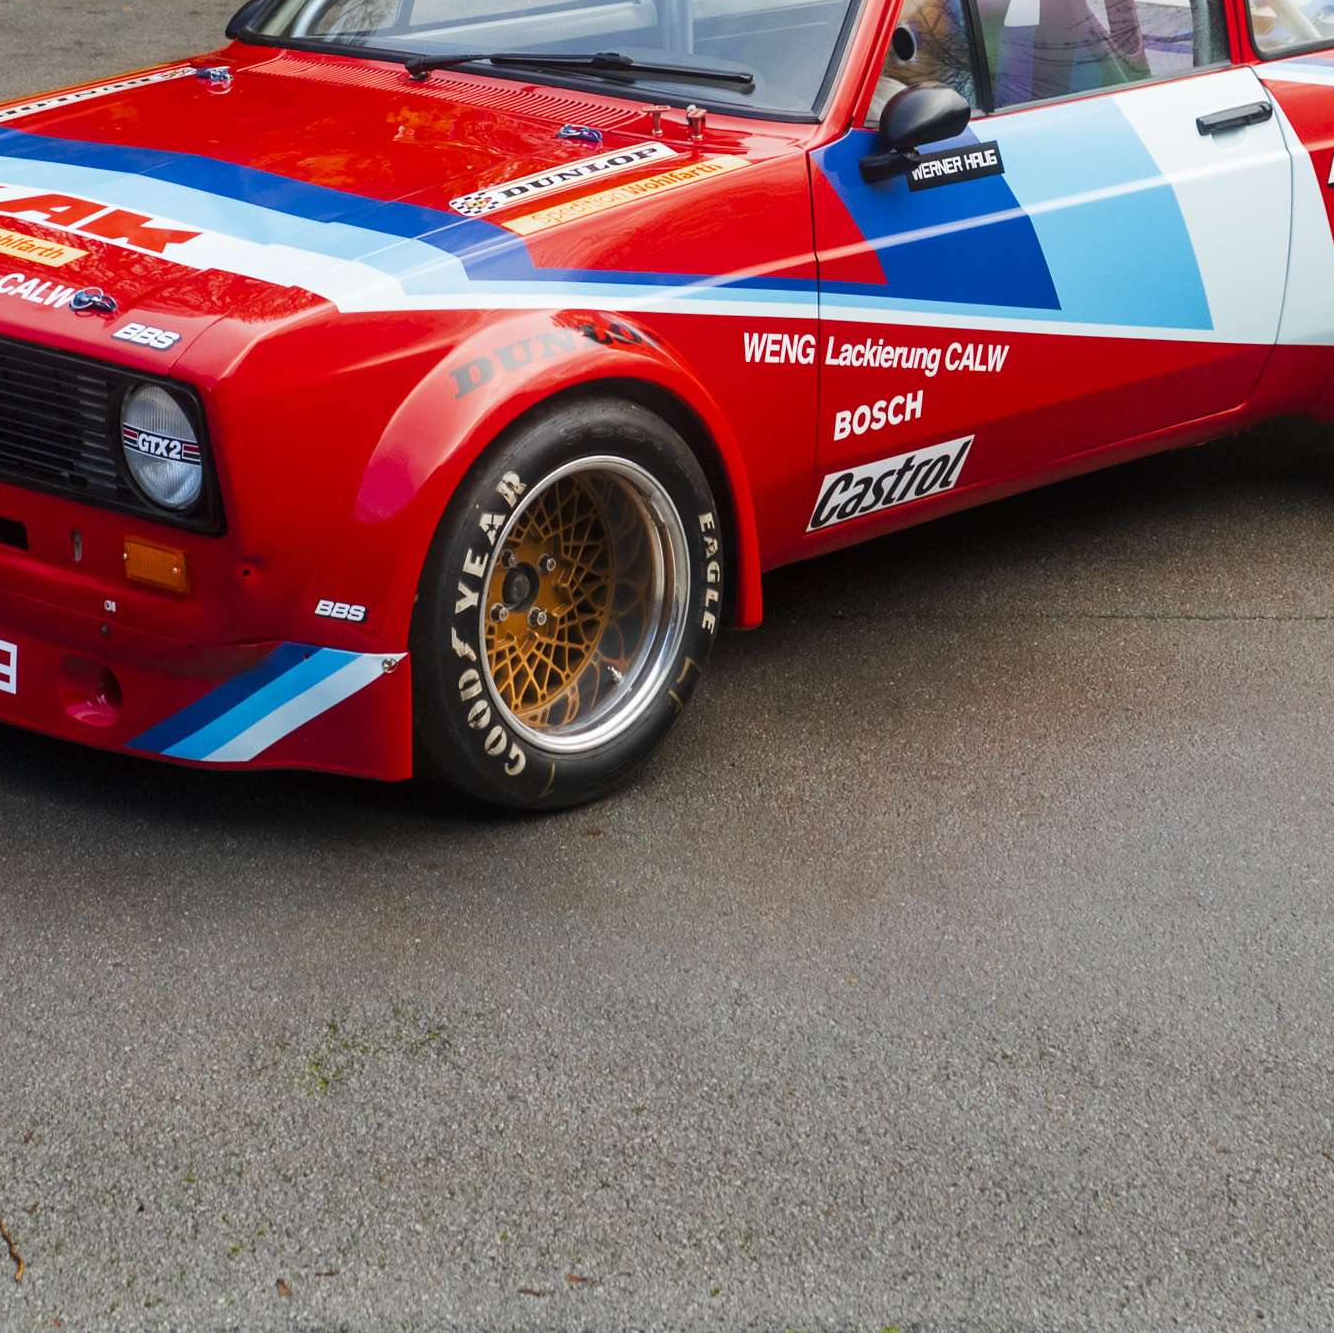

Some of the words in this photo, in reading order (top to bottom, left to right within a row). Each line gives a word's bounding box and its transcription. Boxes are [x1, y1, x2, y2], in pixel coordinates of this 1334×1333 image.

[498, 145, 659, 199] DUNLOP
[911, 155, 963, 181] WERNER
[964, 149, 998, 170] HAUG
[531, 192, 625, 225] Spedition
[624, 162, 723, 195] Wohlfarth
[113, 322, 181, 349] BBS
[743, 332, 816, 365] WENG
[824, 336, 942, 378] Lackierung
[944, 342, 1010, 372] CALW
[833, 389, 924, 442] BOSCH
[138, 433, 182, 460] GTX2
[810, 439, 973, 529] Castrol
[698, 512, 721, 635] EAGLE
[314, 599, 367, 622] BBS
